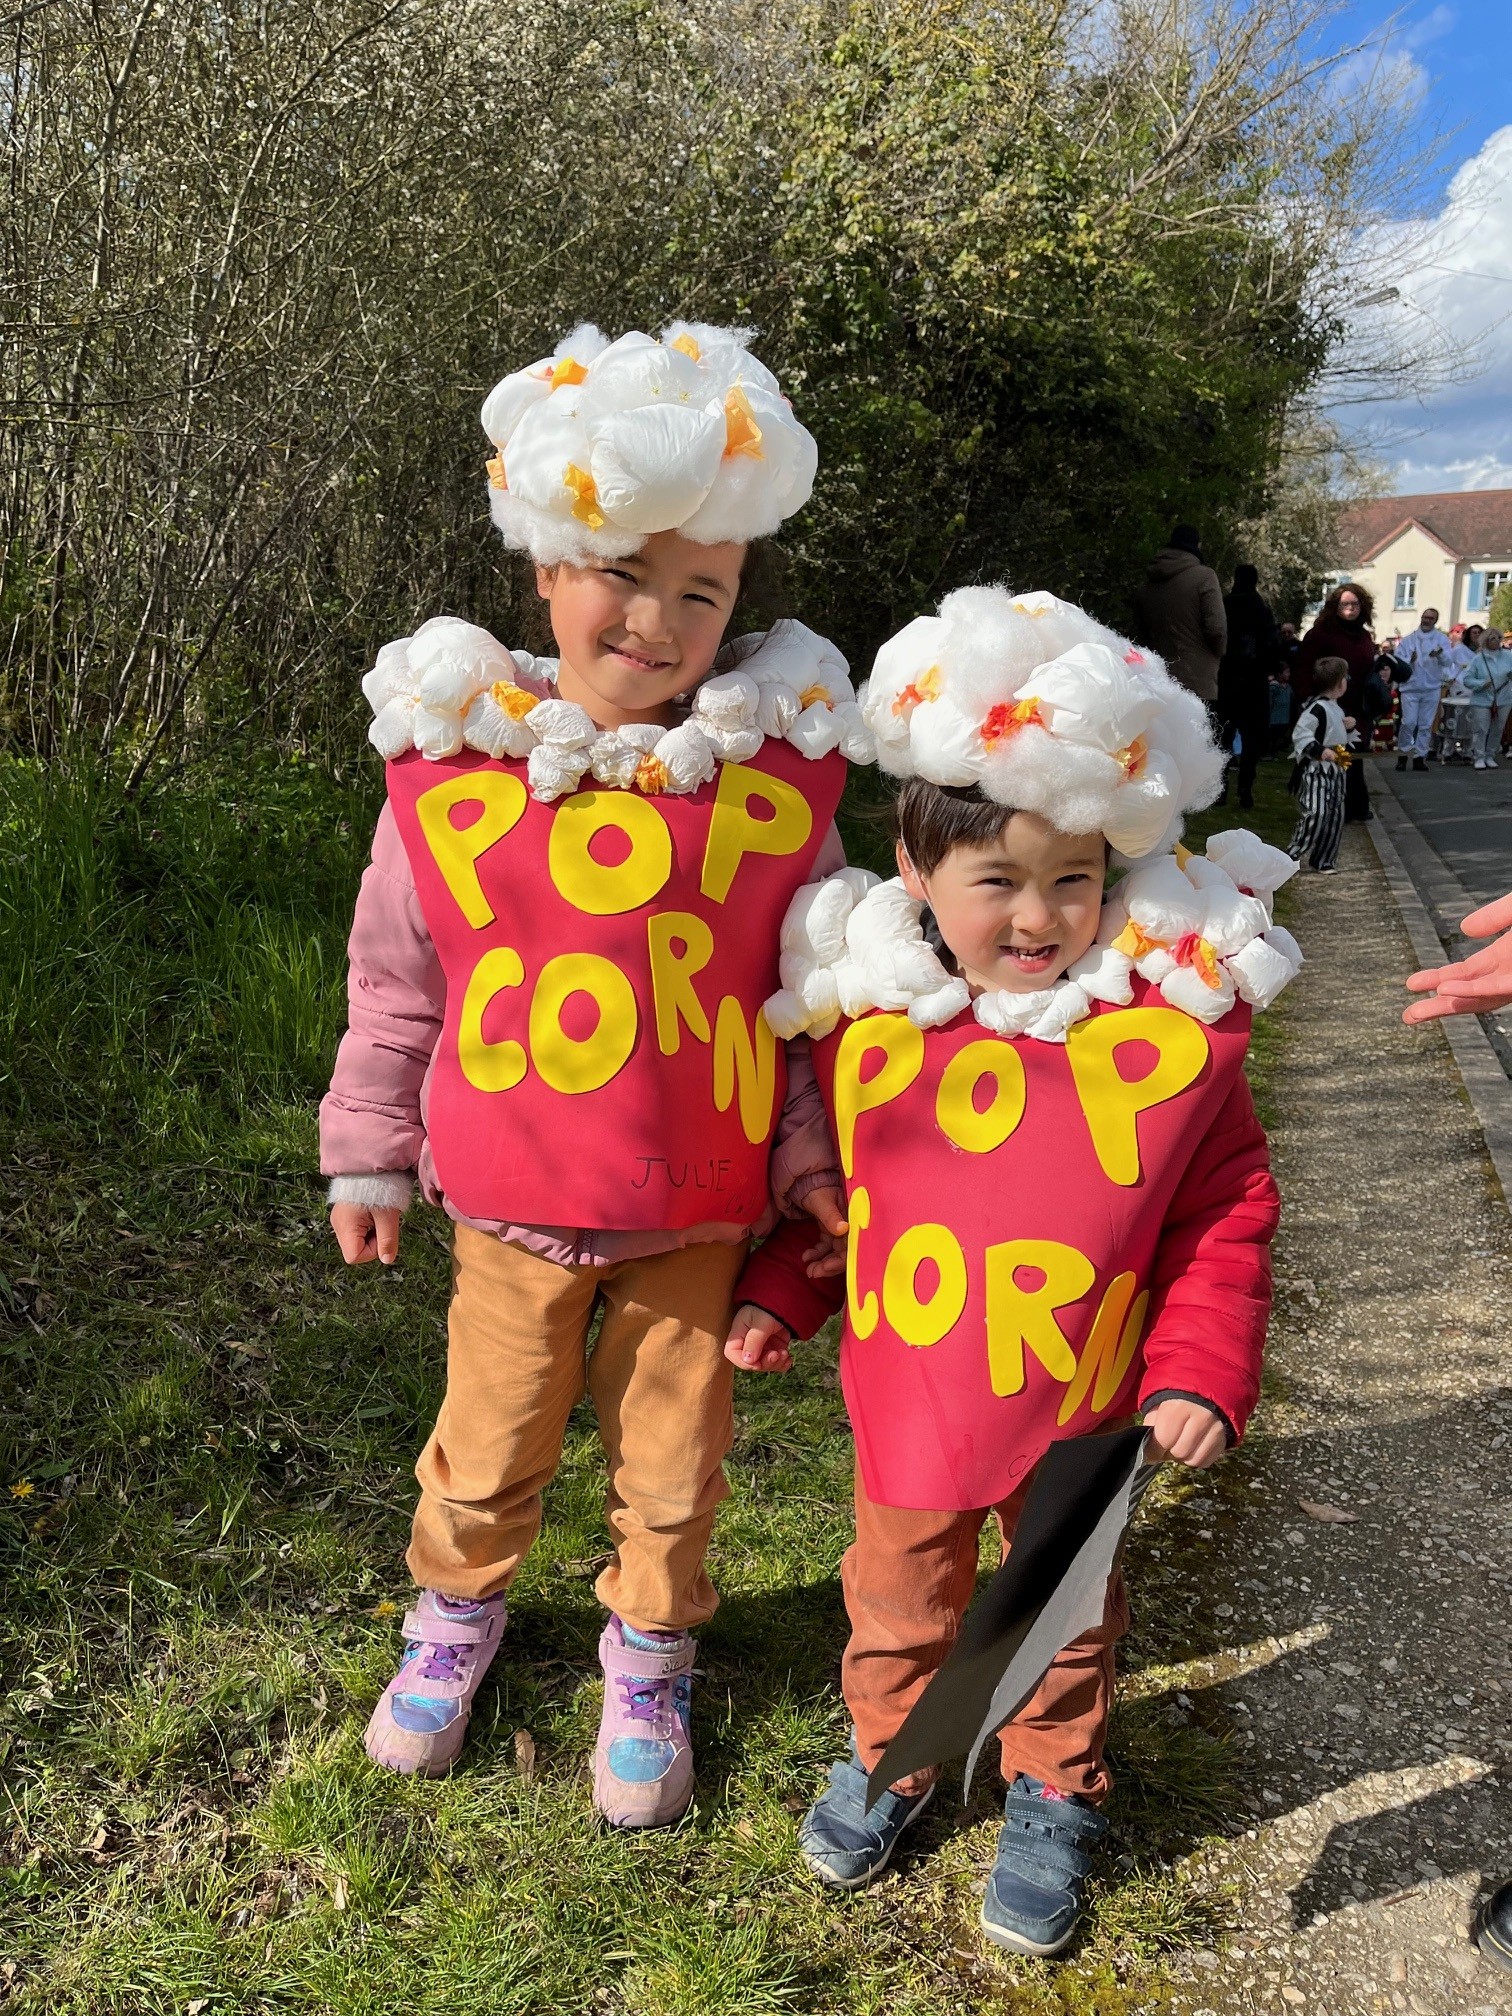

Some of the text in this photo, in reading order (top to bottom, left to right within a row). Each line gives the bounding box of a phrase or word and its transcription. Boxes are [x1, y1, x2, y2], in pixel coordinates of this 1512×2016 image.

[416, 761, 812, 930] POP
[457, 911, 777, 1145] CORN
[834, 1006, 1209, 1187] POP
[631, 1156, 732, 1193] JULIE
[846, 1186, 1149, 1427] CORN
